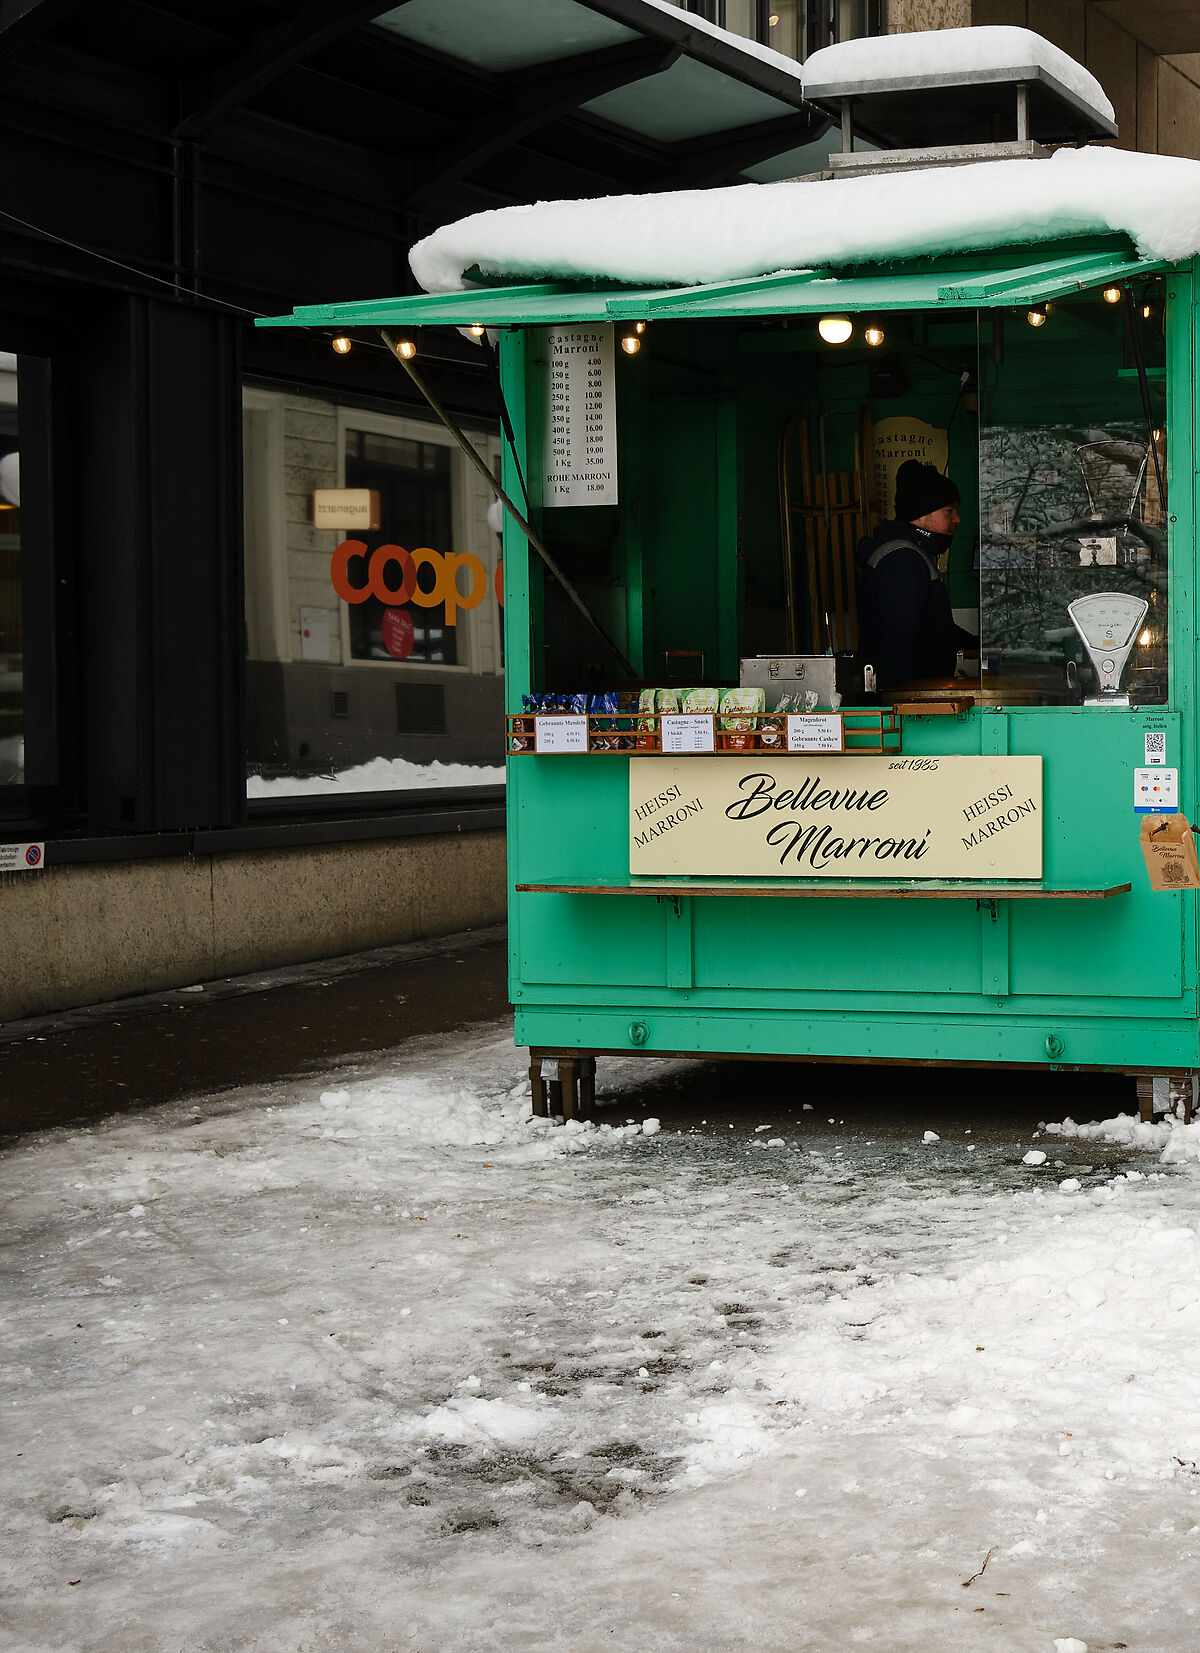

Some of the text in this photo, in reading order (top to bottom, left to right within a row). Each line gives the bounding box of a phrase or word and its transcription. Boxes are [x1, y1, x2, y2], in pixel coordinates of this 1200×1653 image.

[548, 334, 604, 344] Castagne
[553, 343, 599, 354] Marroni
[878, 433, 934, 445] astagne
[331, 540, 486, 626] coop
[888, 758, 941, 771] seit 1985
[634, 784, 683, 821] HEISSI
[724, 773, 890, 820] Bellevue
[962, 784, 1014, 823] HEISSI
[633, 798, 706, 849] MARRONI
[961, 798, 1038, 851] MARRONI
[766, 821, 932, 870] Marroni
